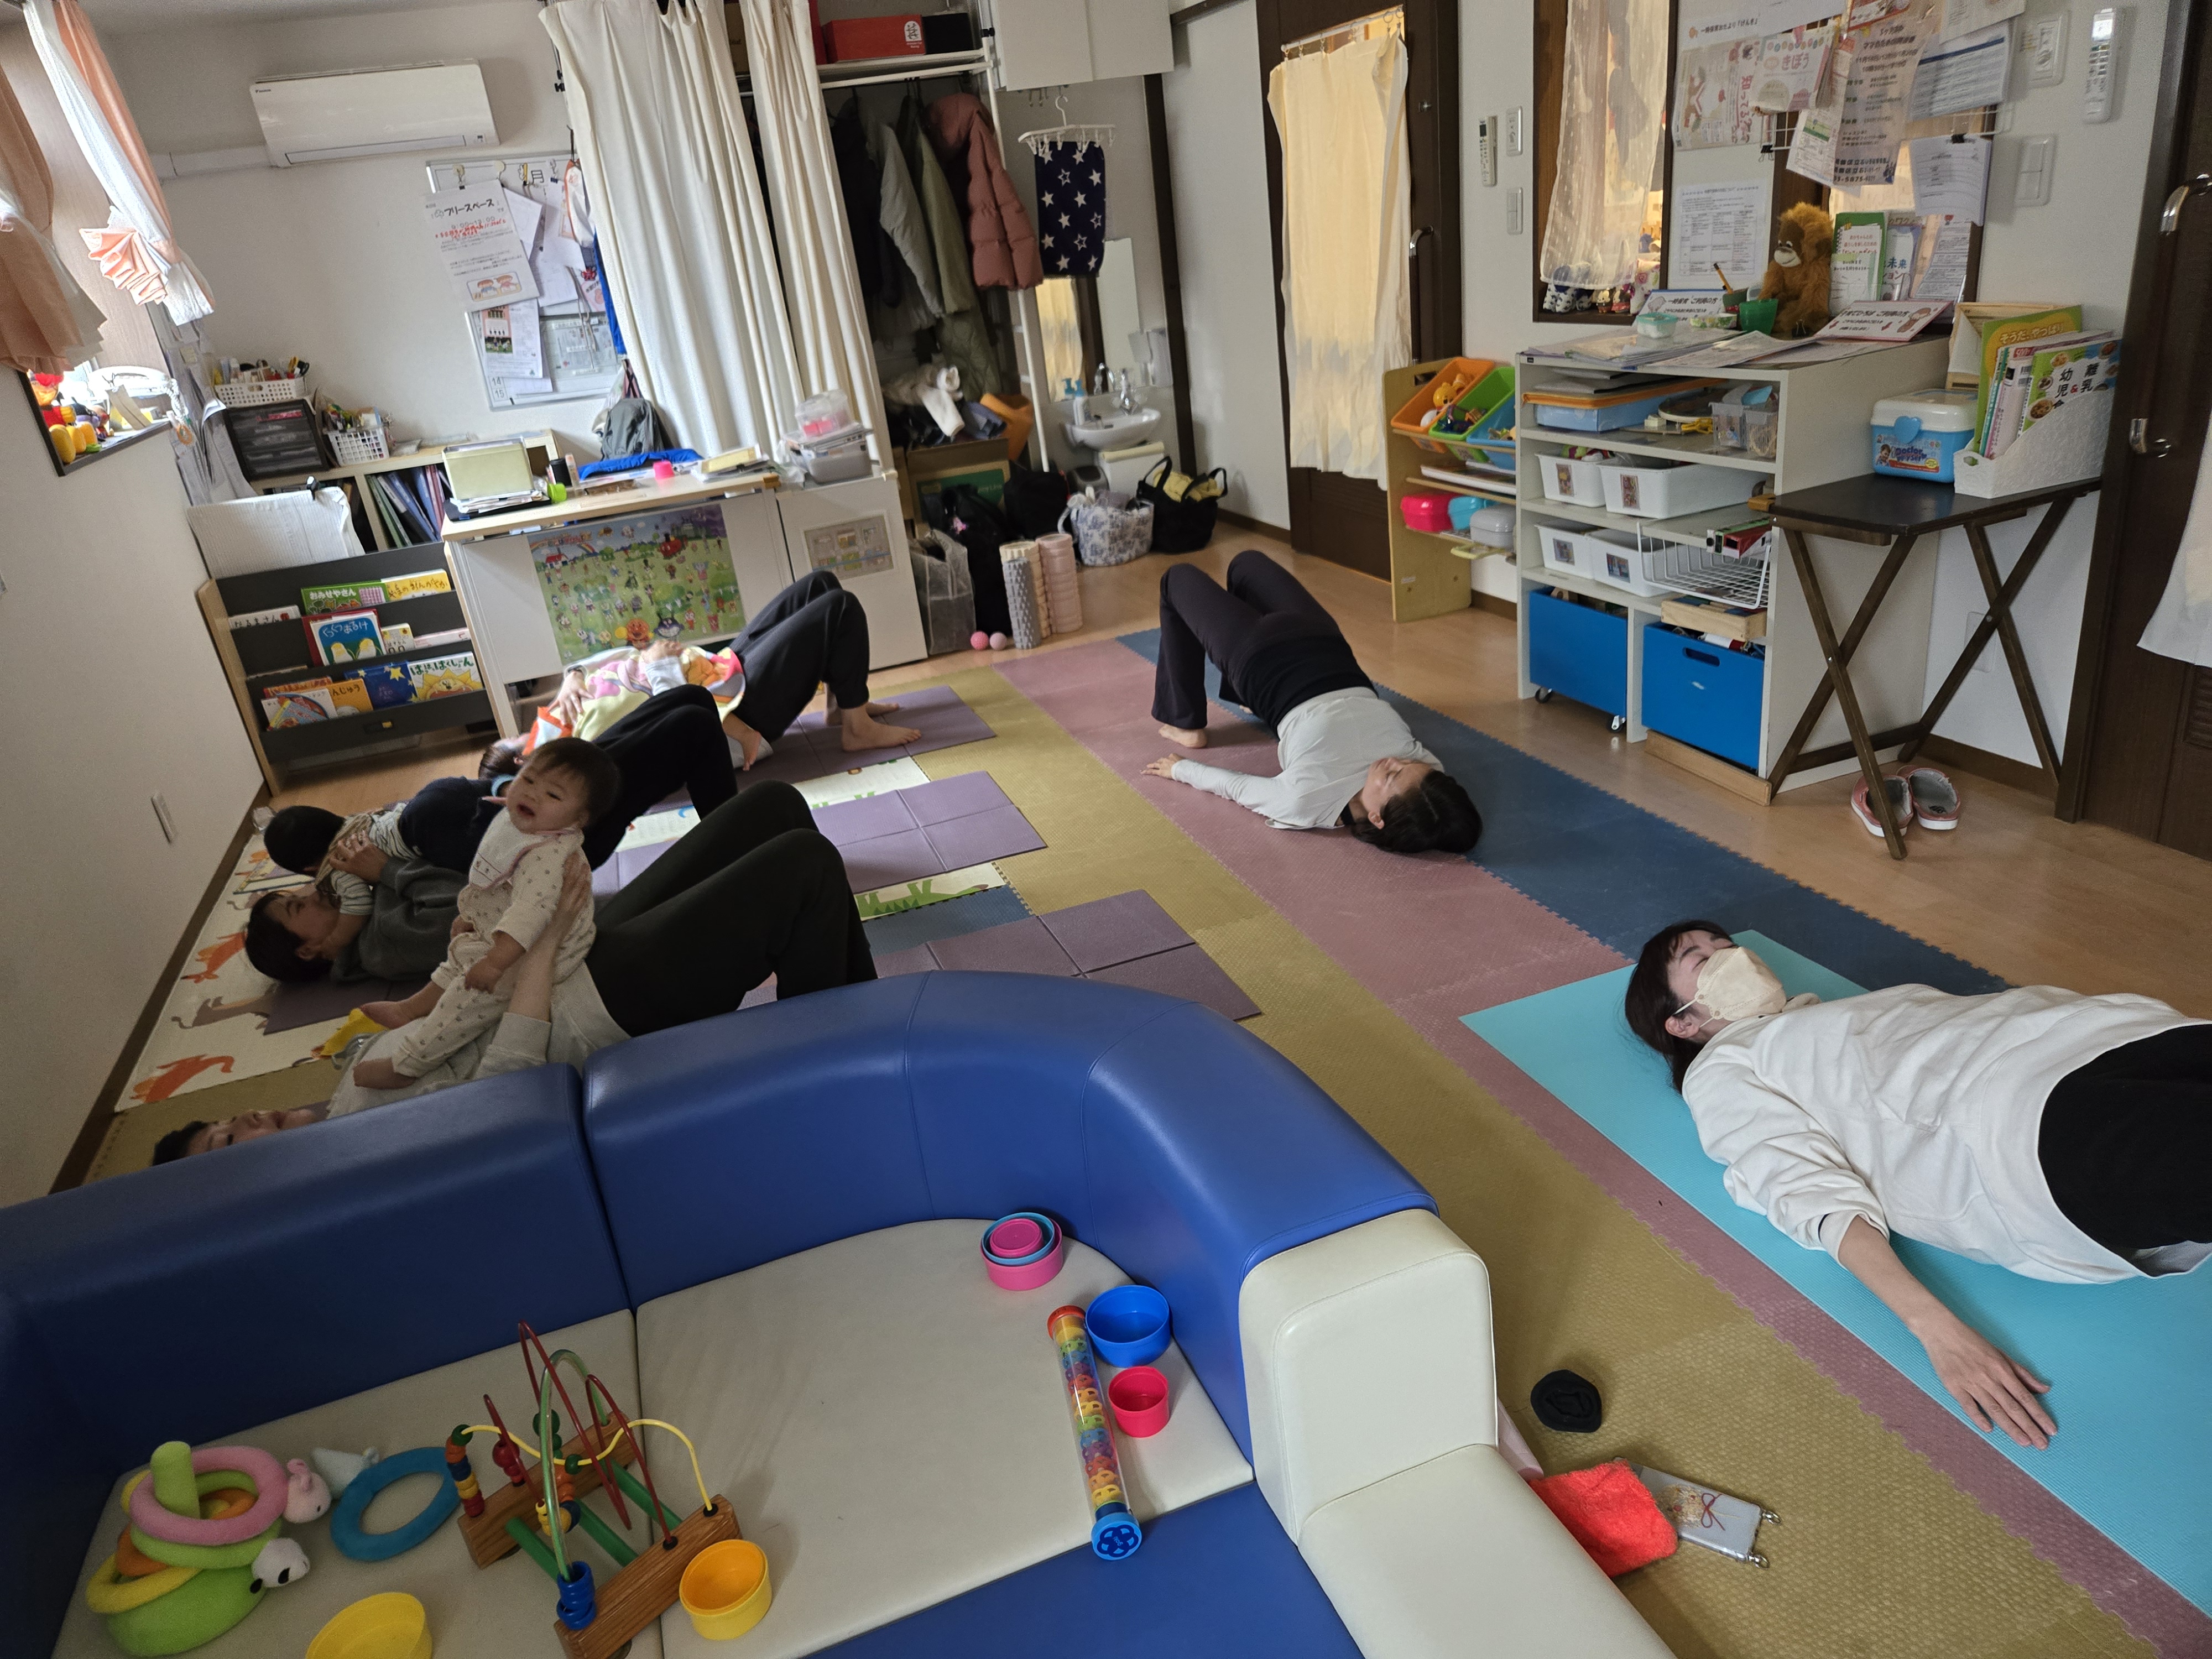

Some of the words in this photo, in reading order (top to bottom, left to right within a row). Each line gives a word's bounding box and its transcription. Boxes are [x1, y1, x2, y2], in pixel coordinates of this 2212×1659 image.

[531, 170, 544, 184] 月
[444, 199, 494, 216] フリースペース
[1884, 257, 1907, 269] 未来
[492, 377, 502, 386] 14
[310, 587, 357, 600] おみせやさん
[332, 683, 361, 697] んじゅう
